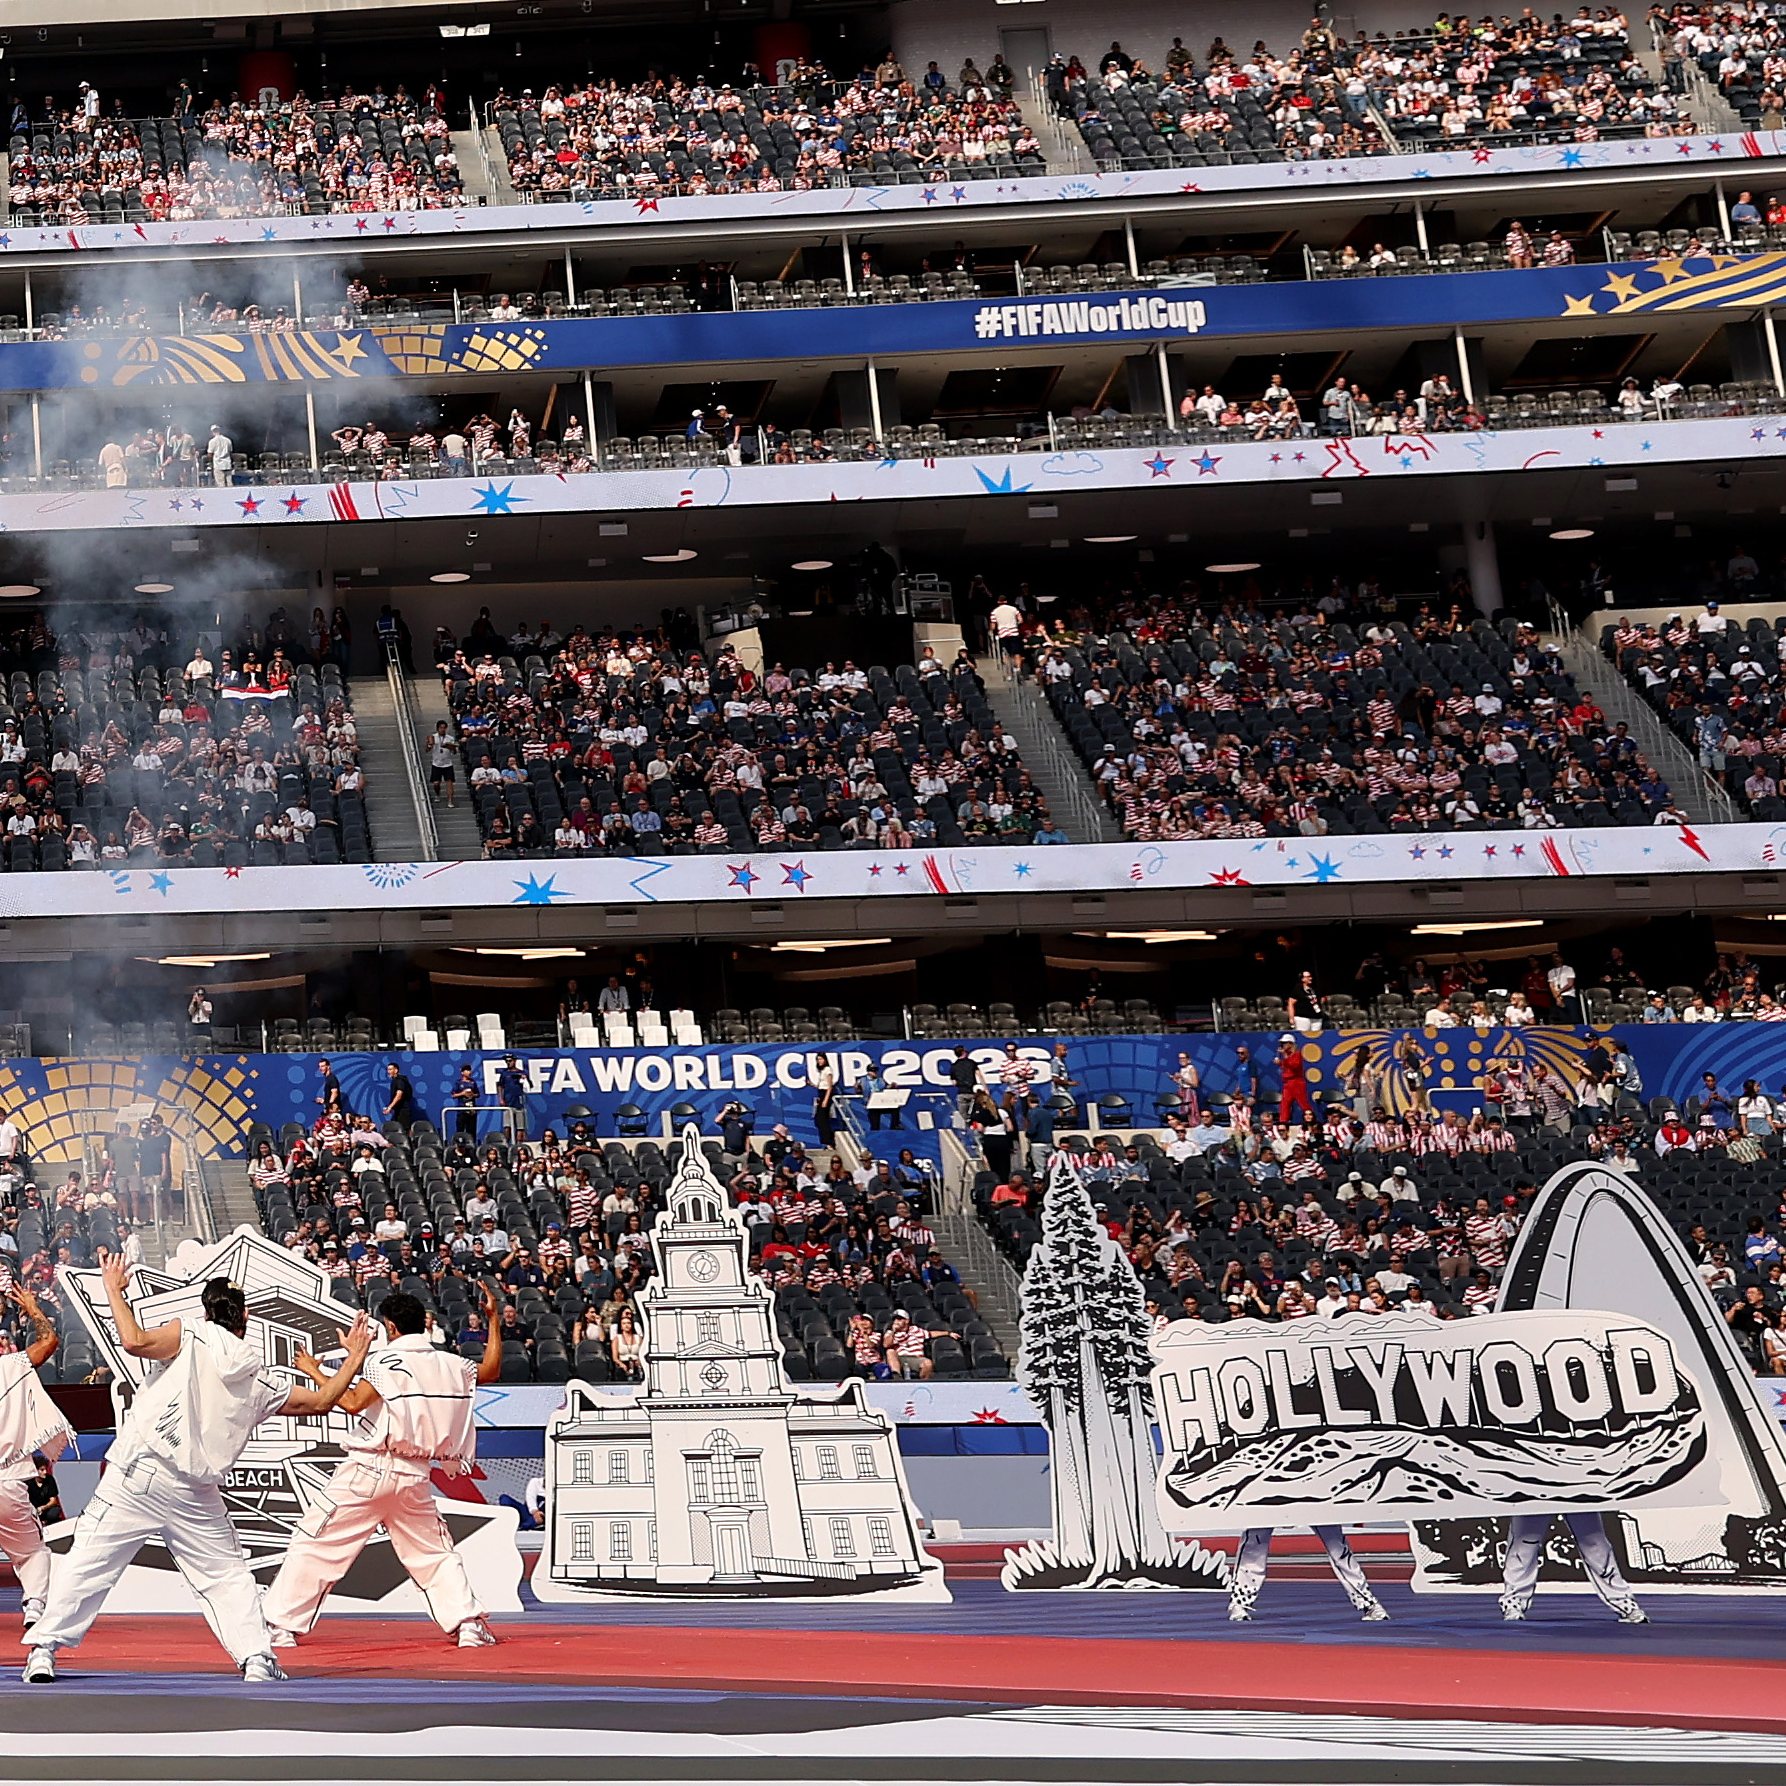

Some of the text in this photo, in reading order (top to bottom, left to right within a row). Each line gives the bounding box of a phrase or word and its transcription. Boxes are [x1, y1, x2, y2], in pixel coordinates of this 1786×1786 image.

[974, 296, 1207, 339] #FIFAWorldCup
[590, 1054, 769, 1093] WORLD
[1159, 1327, 1680, 1451] HOLLYWOOD
[224, 1470, 284, 1488] BEACH
